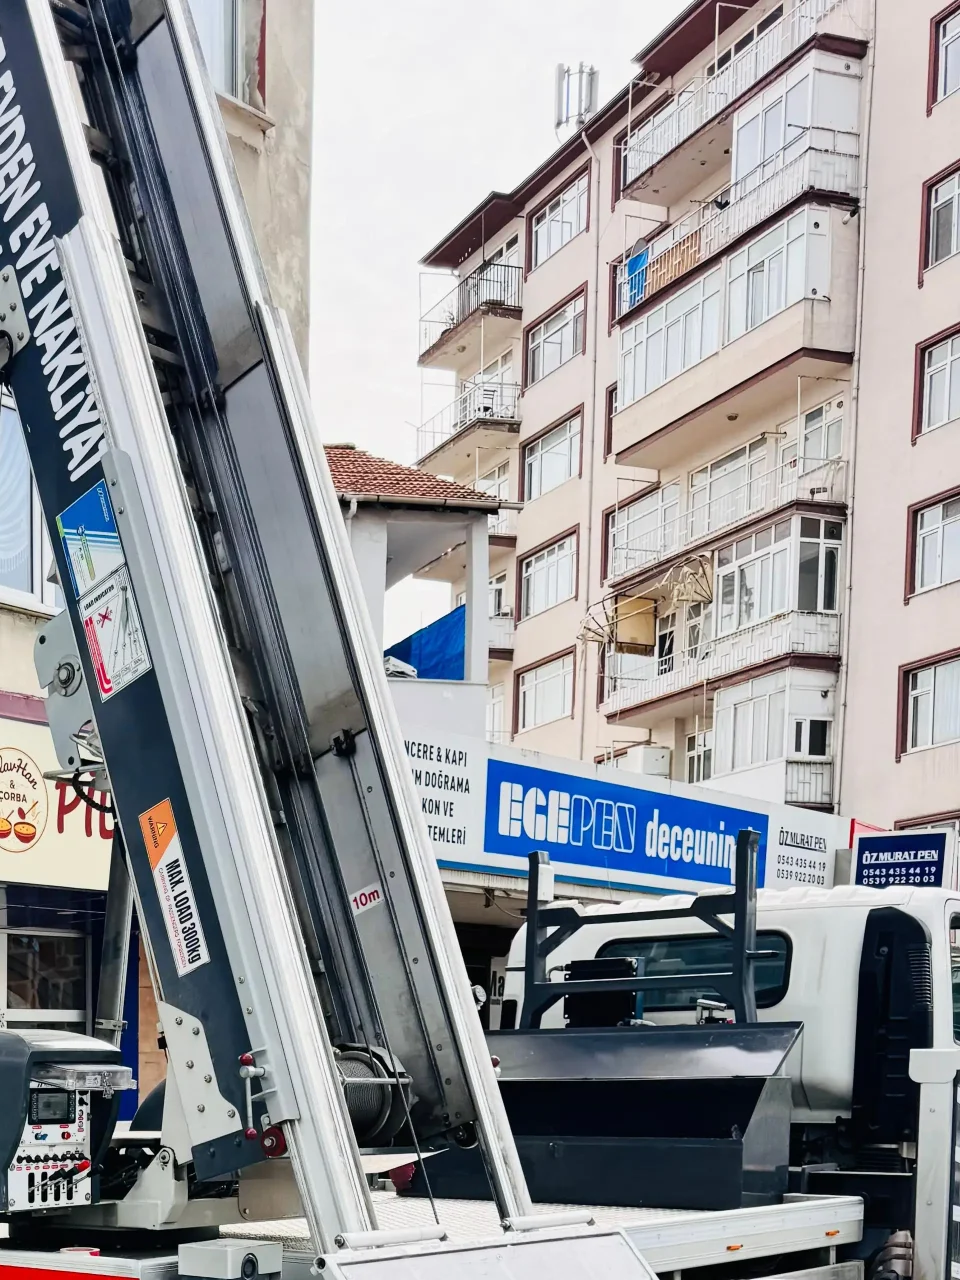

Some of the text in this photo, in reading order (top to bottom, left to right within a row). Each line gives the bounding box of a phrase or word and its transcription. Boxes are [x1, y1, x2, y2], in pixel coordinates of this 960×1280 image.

[8, 202, 61, 299] EVE
[436, 746, 443, 762] &
[444, 748, 468, 768] KAPI
[424, 769, 471, 794] DOĞRAMA
[422, 797, 455, 818] KON VE
[147, 816, 160, 849] WARNING
[645, 808, 753, 870] deceunin
[778, 827, 790, 846] ÖZ
[814, 836, 827, 850] PEN
[777, 854, 826, 872] 0543 435 44 19
[862, 849, 939, 865] ÖZ MURAT PEN
[776, 868, 825, 886] 0539 922 20 03
[862, 866, 937, 877] 0543 435 44 19
[862, 875, 935, 885] 0539 922 20 03
[352, 889, 380, 910] 10m
[165, 858, 202, 965] MAX. LOAD 300kg
